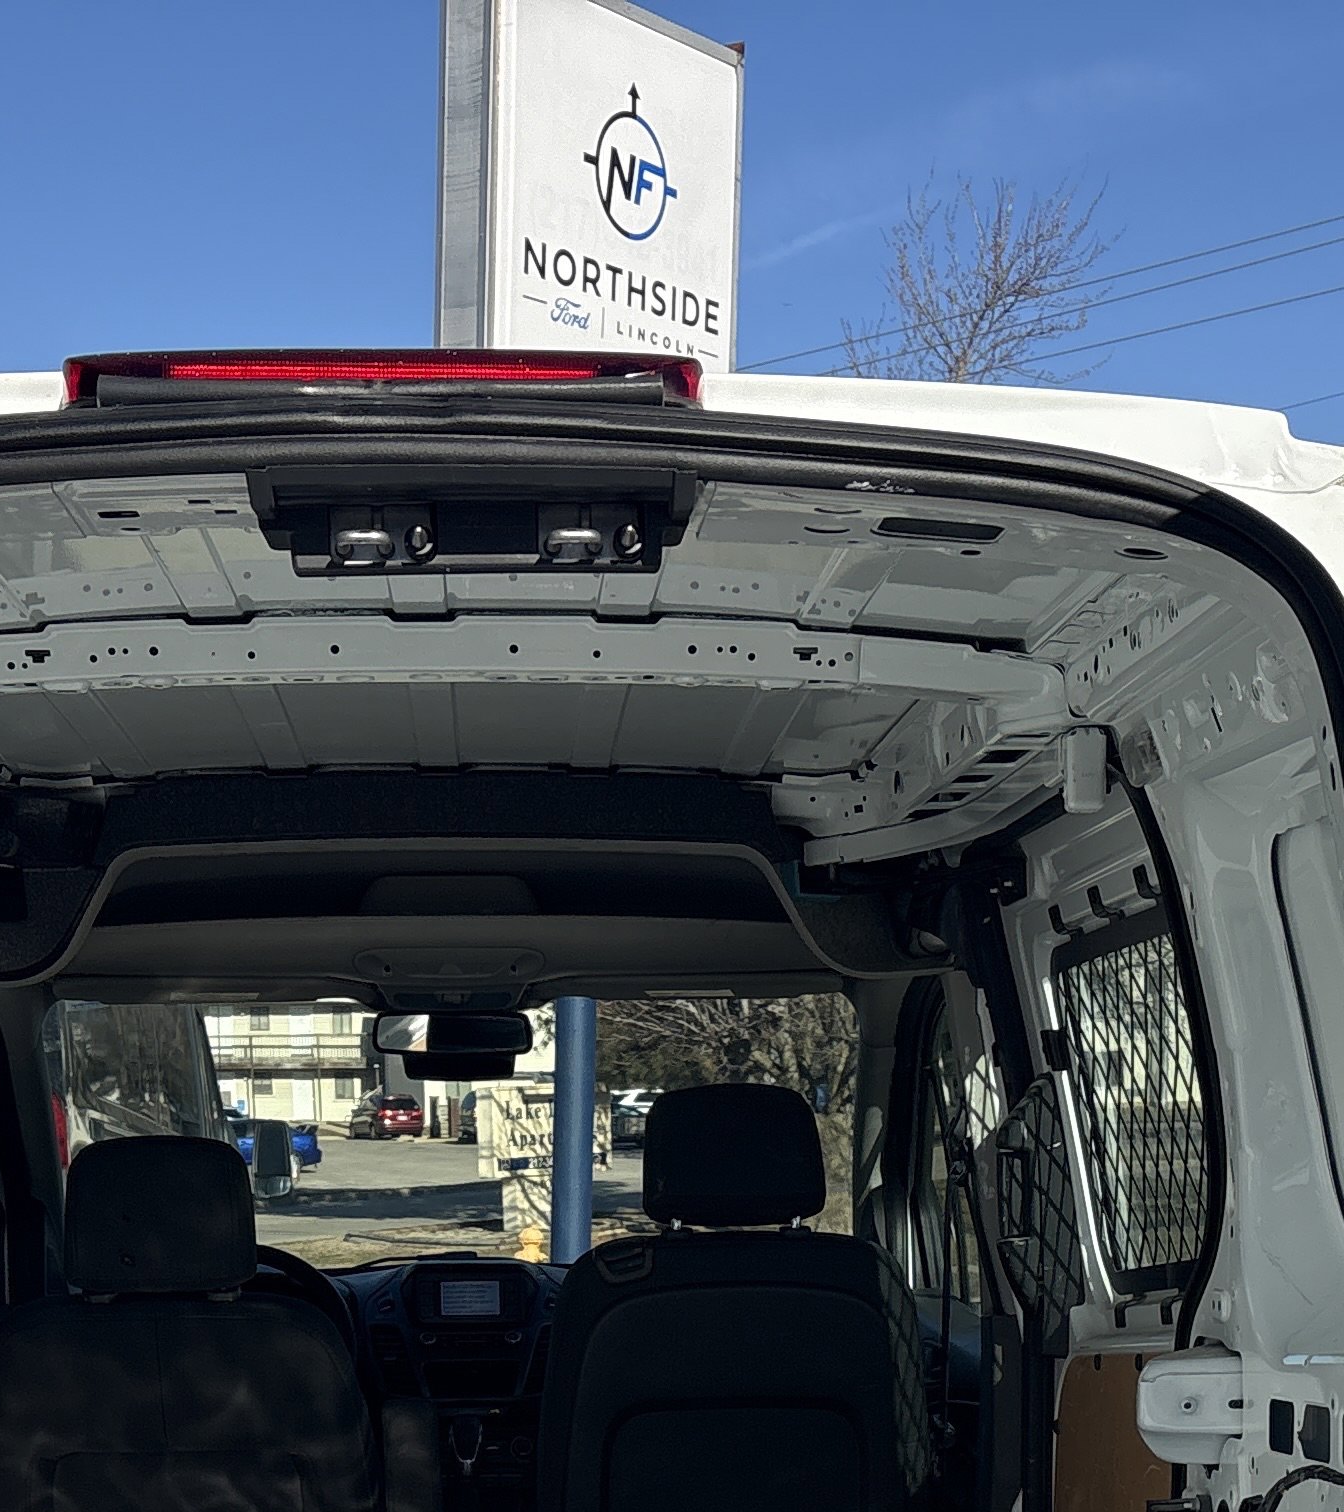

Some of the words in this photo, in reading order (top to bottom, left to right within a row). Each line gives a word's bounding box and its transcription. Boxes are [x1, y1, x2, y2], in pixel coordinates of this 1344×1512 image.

[607, 146, 666, 207] NF
[523, 236, 720, 336] NORTHSIDE
[550, 297, 591, 330] Ford
[616, 320, 695, 357] LINCOLN
[504, 1100, 542, 1120] Lake
